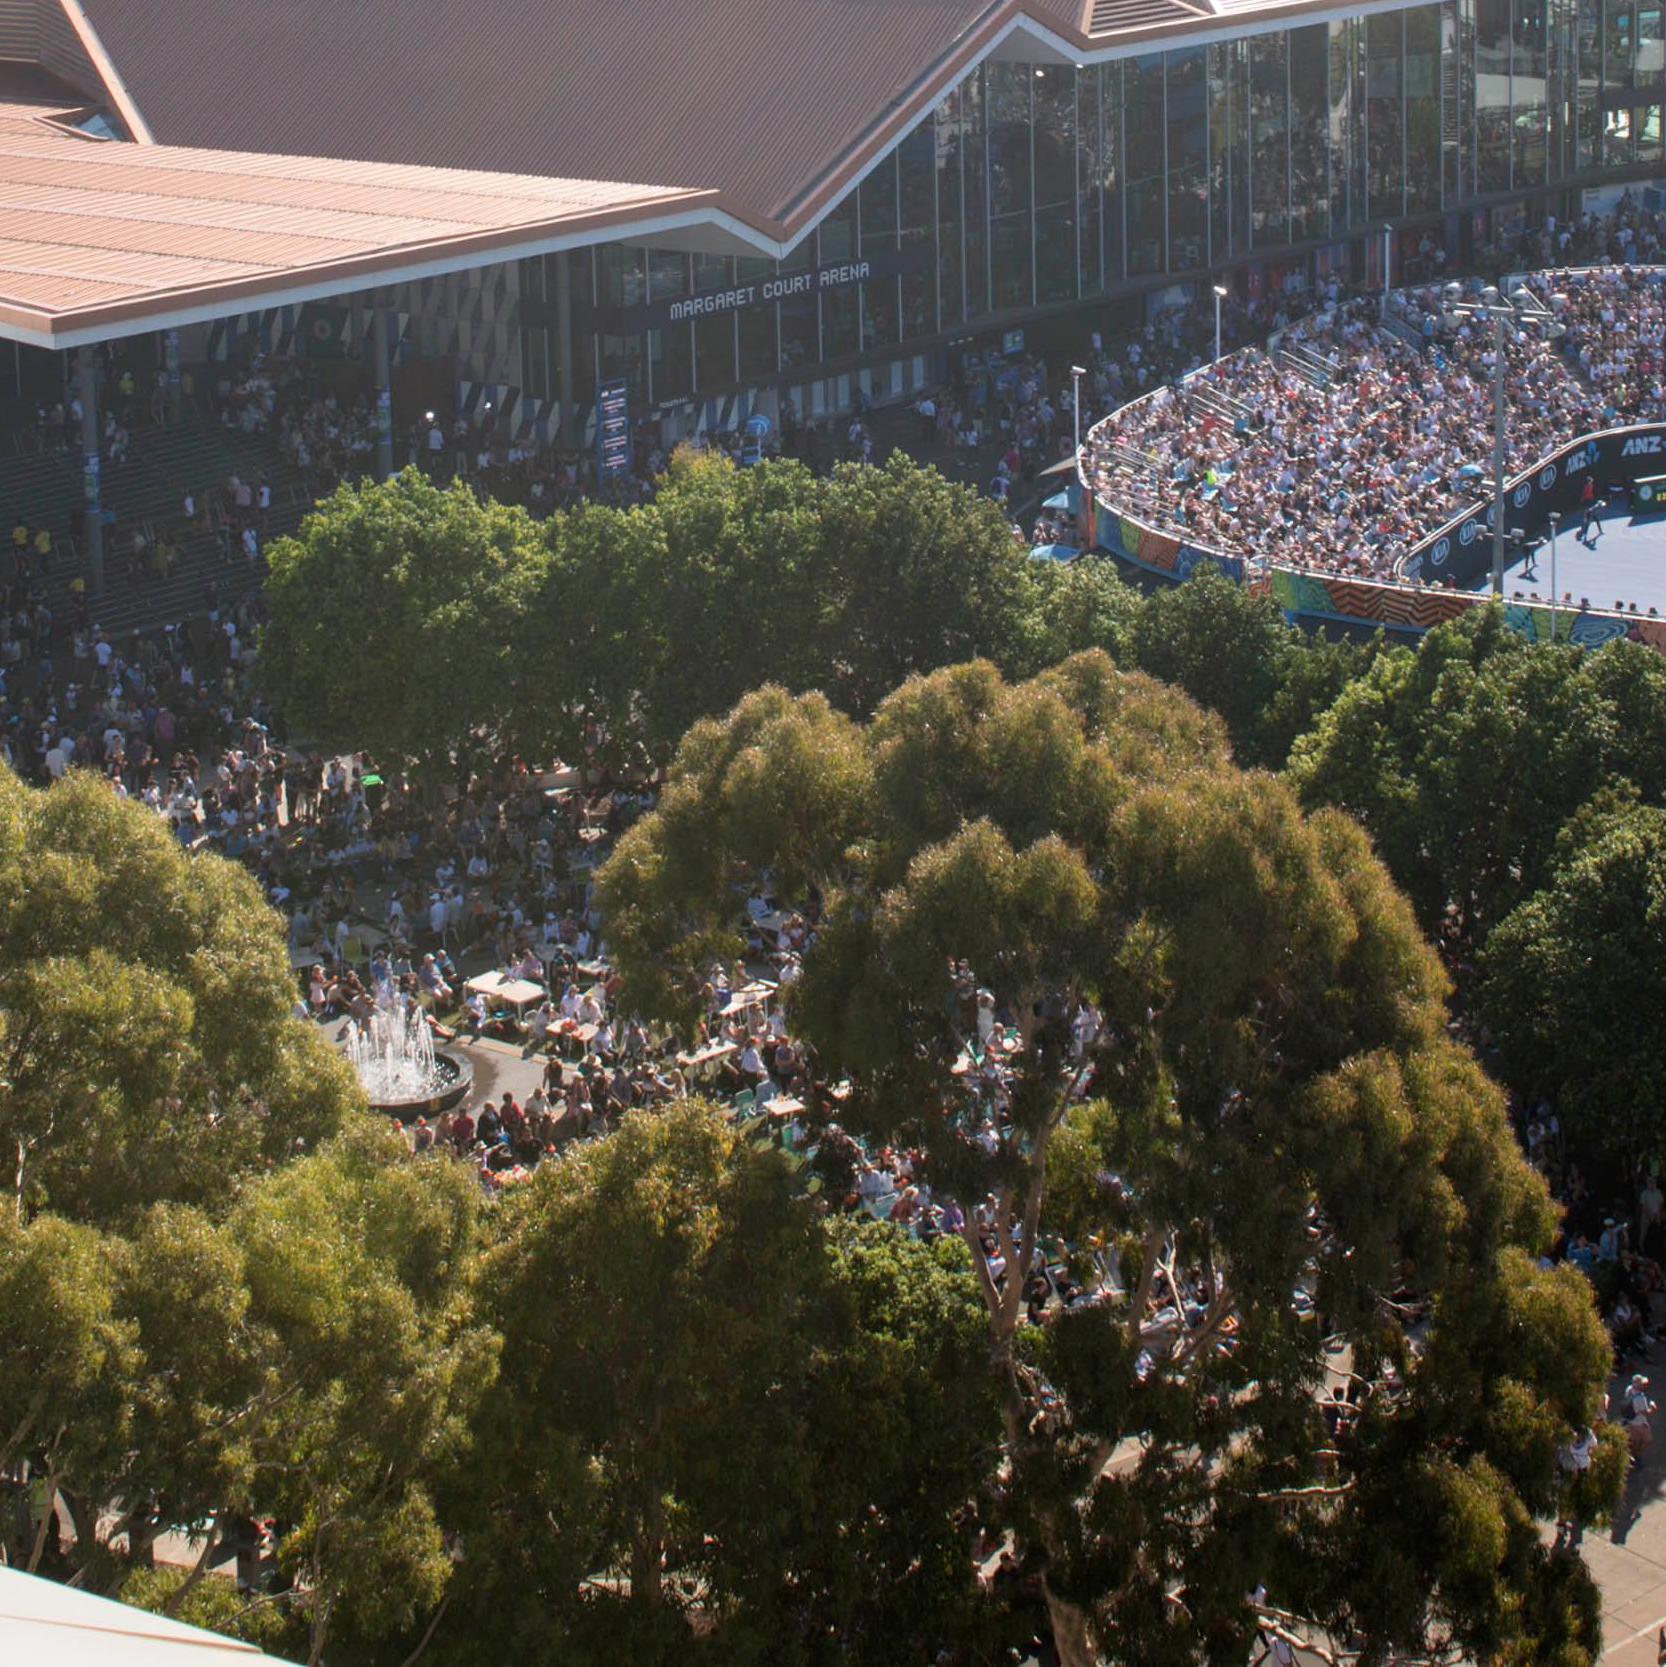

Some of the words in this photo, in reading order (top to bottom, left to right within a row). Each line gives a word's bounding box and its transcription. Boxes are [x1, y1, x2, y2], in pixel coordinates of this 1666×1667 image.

[670, 286, 755, 321] MARGARET
[763, 274, 813, 300] COURT
[819, 261, 870, 287] ARENA
[1620, 435, 1661, 458] ANZ
[1565, 451, 1587, 477] ANZ
